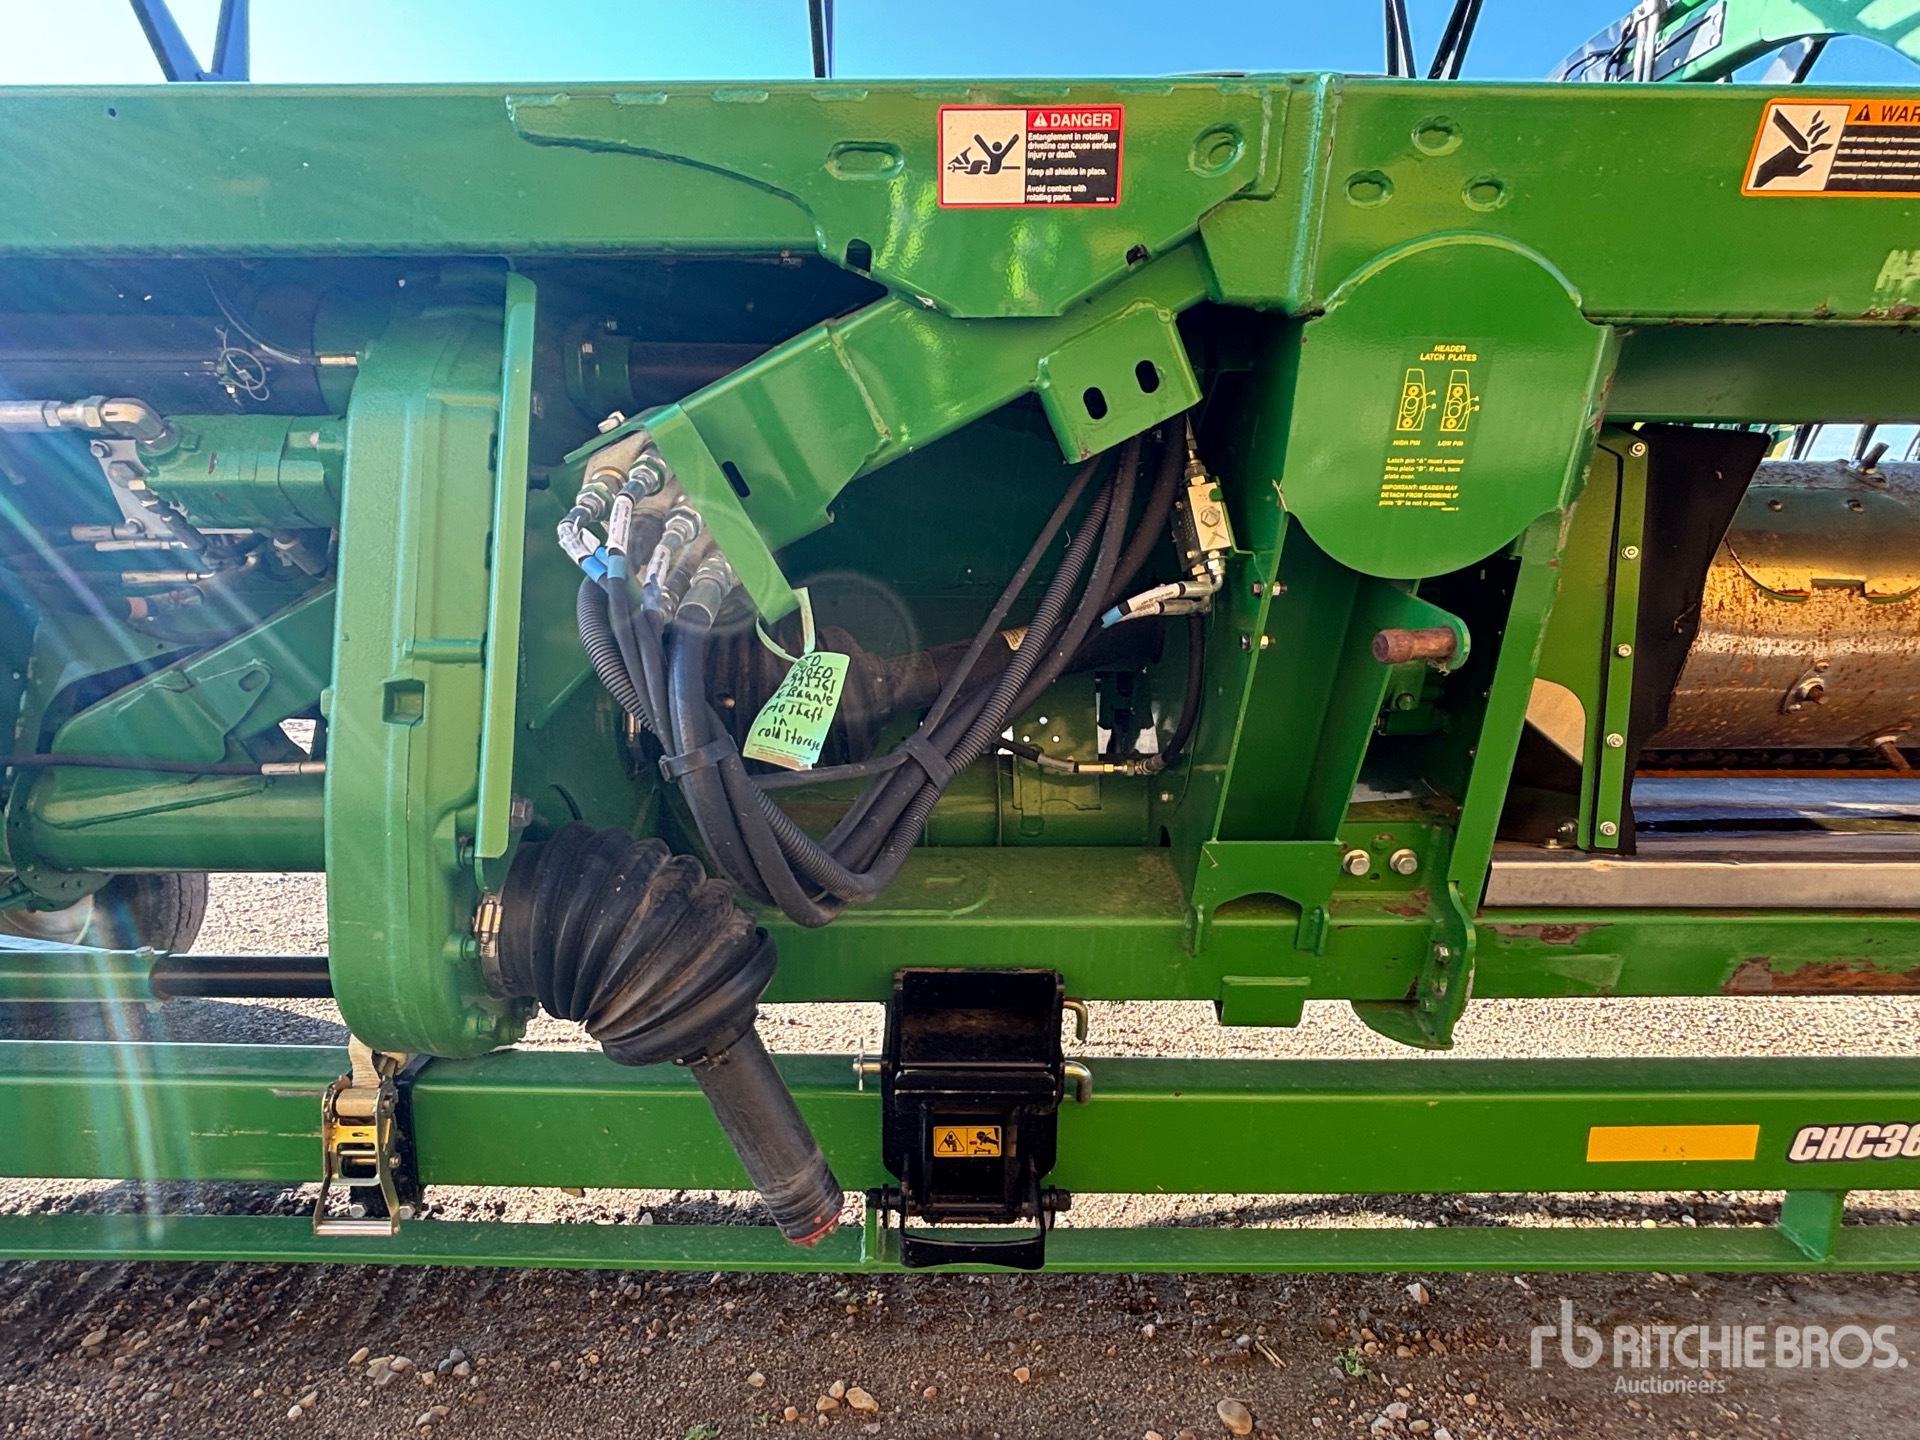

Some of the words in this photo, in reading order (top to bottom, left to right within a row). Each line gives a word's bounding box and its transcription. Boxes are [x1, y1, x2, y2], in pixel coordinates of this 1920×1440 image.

[1050, 113, 1112, 127] DANGER
[1028, 133, 1073, 142] Entanglement
[1082, 133, 1108, 142] rotating
[1028, 151, 1046, 160] injury
[1027, 168, 1044, 177] Keep
[1087, 168, 1107, 177] place.
[1072, 184, 1086, 192] with
[1026, 194, 1052, 203] rotating
[1053, 194, 1072, 203] parts.
[1420, 353, 1445, 361] LATCH
[1448, 353, 1477, 361] PLATES
[789, 703, 823, 723] shaft
[774, 714, 787, 726] in
[785, 728, 821, 751] storage
